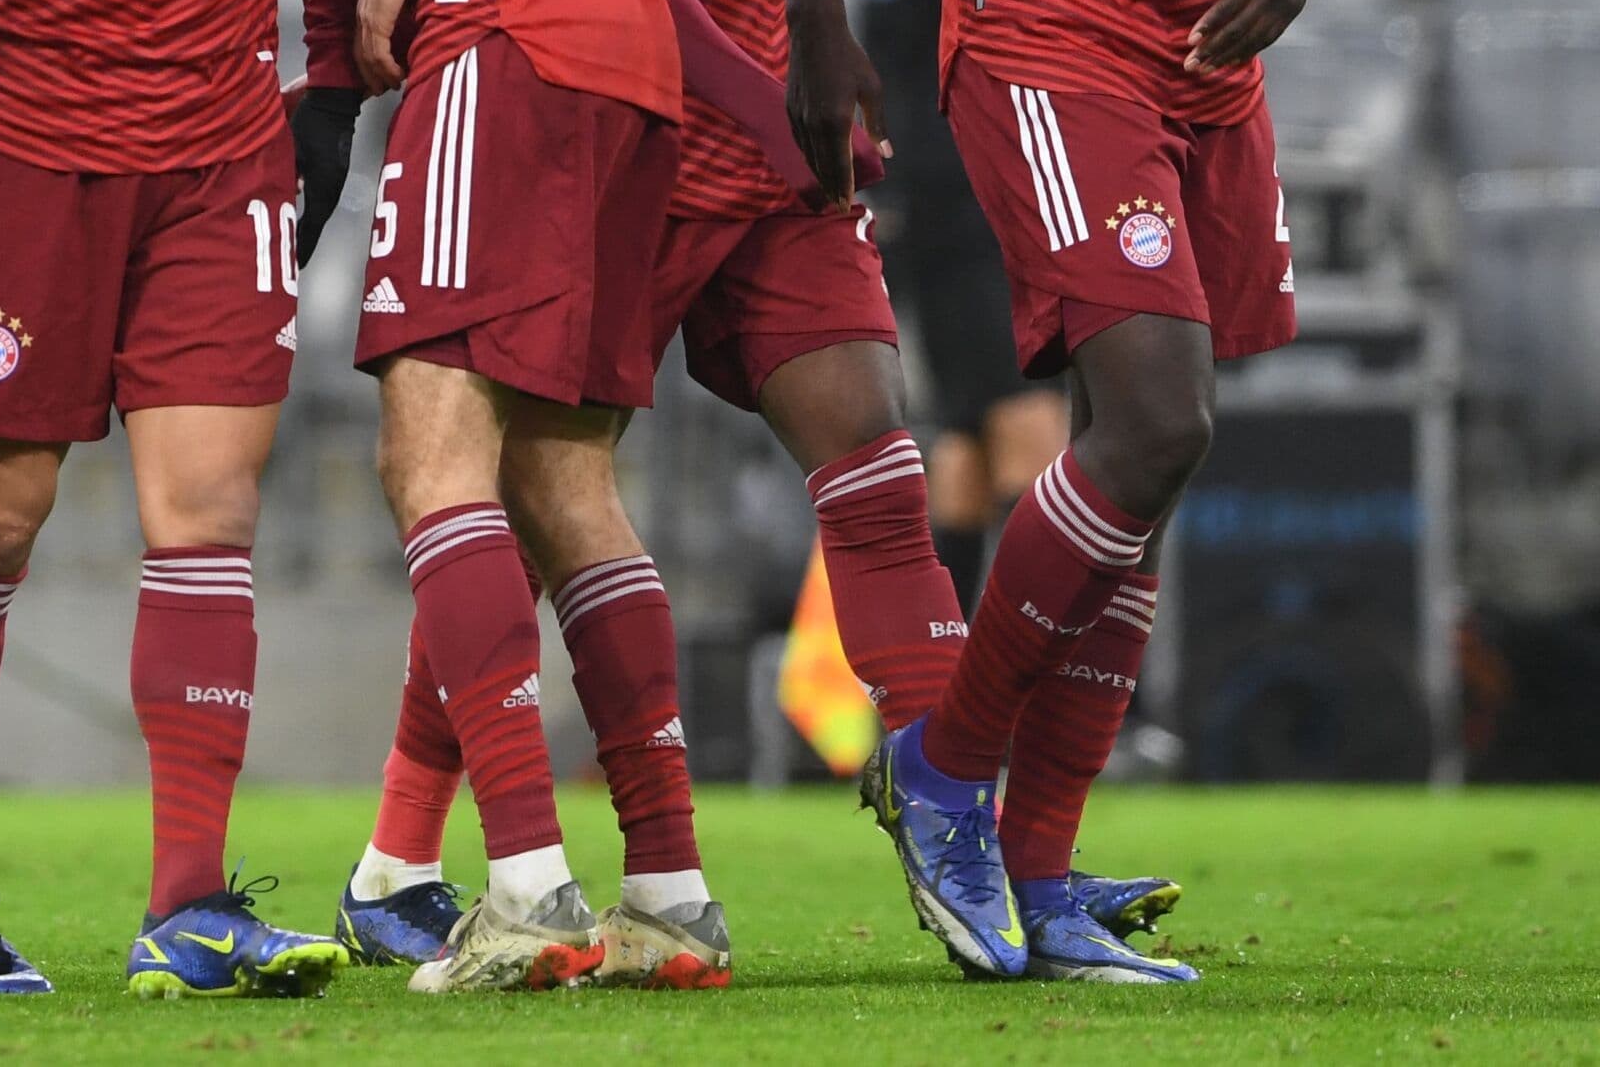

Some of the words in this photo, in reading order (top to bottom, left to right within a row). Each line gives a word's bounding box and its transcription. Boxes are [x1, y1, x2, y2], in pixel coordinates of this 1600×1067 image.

[370, 163, 403, 259] 5
[246, 199, 298, 297] 10
[363, 300, 406, 314] adidas
[503, 692, 540, 709] adid
